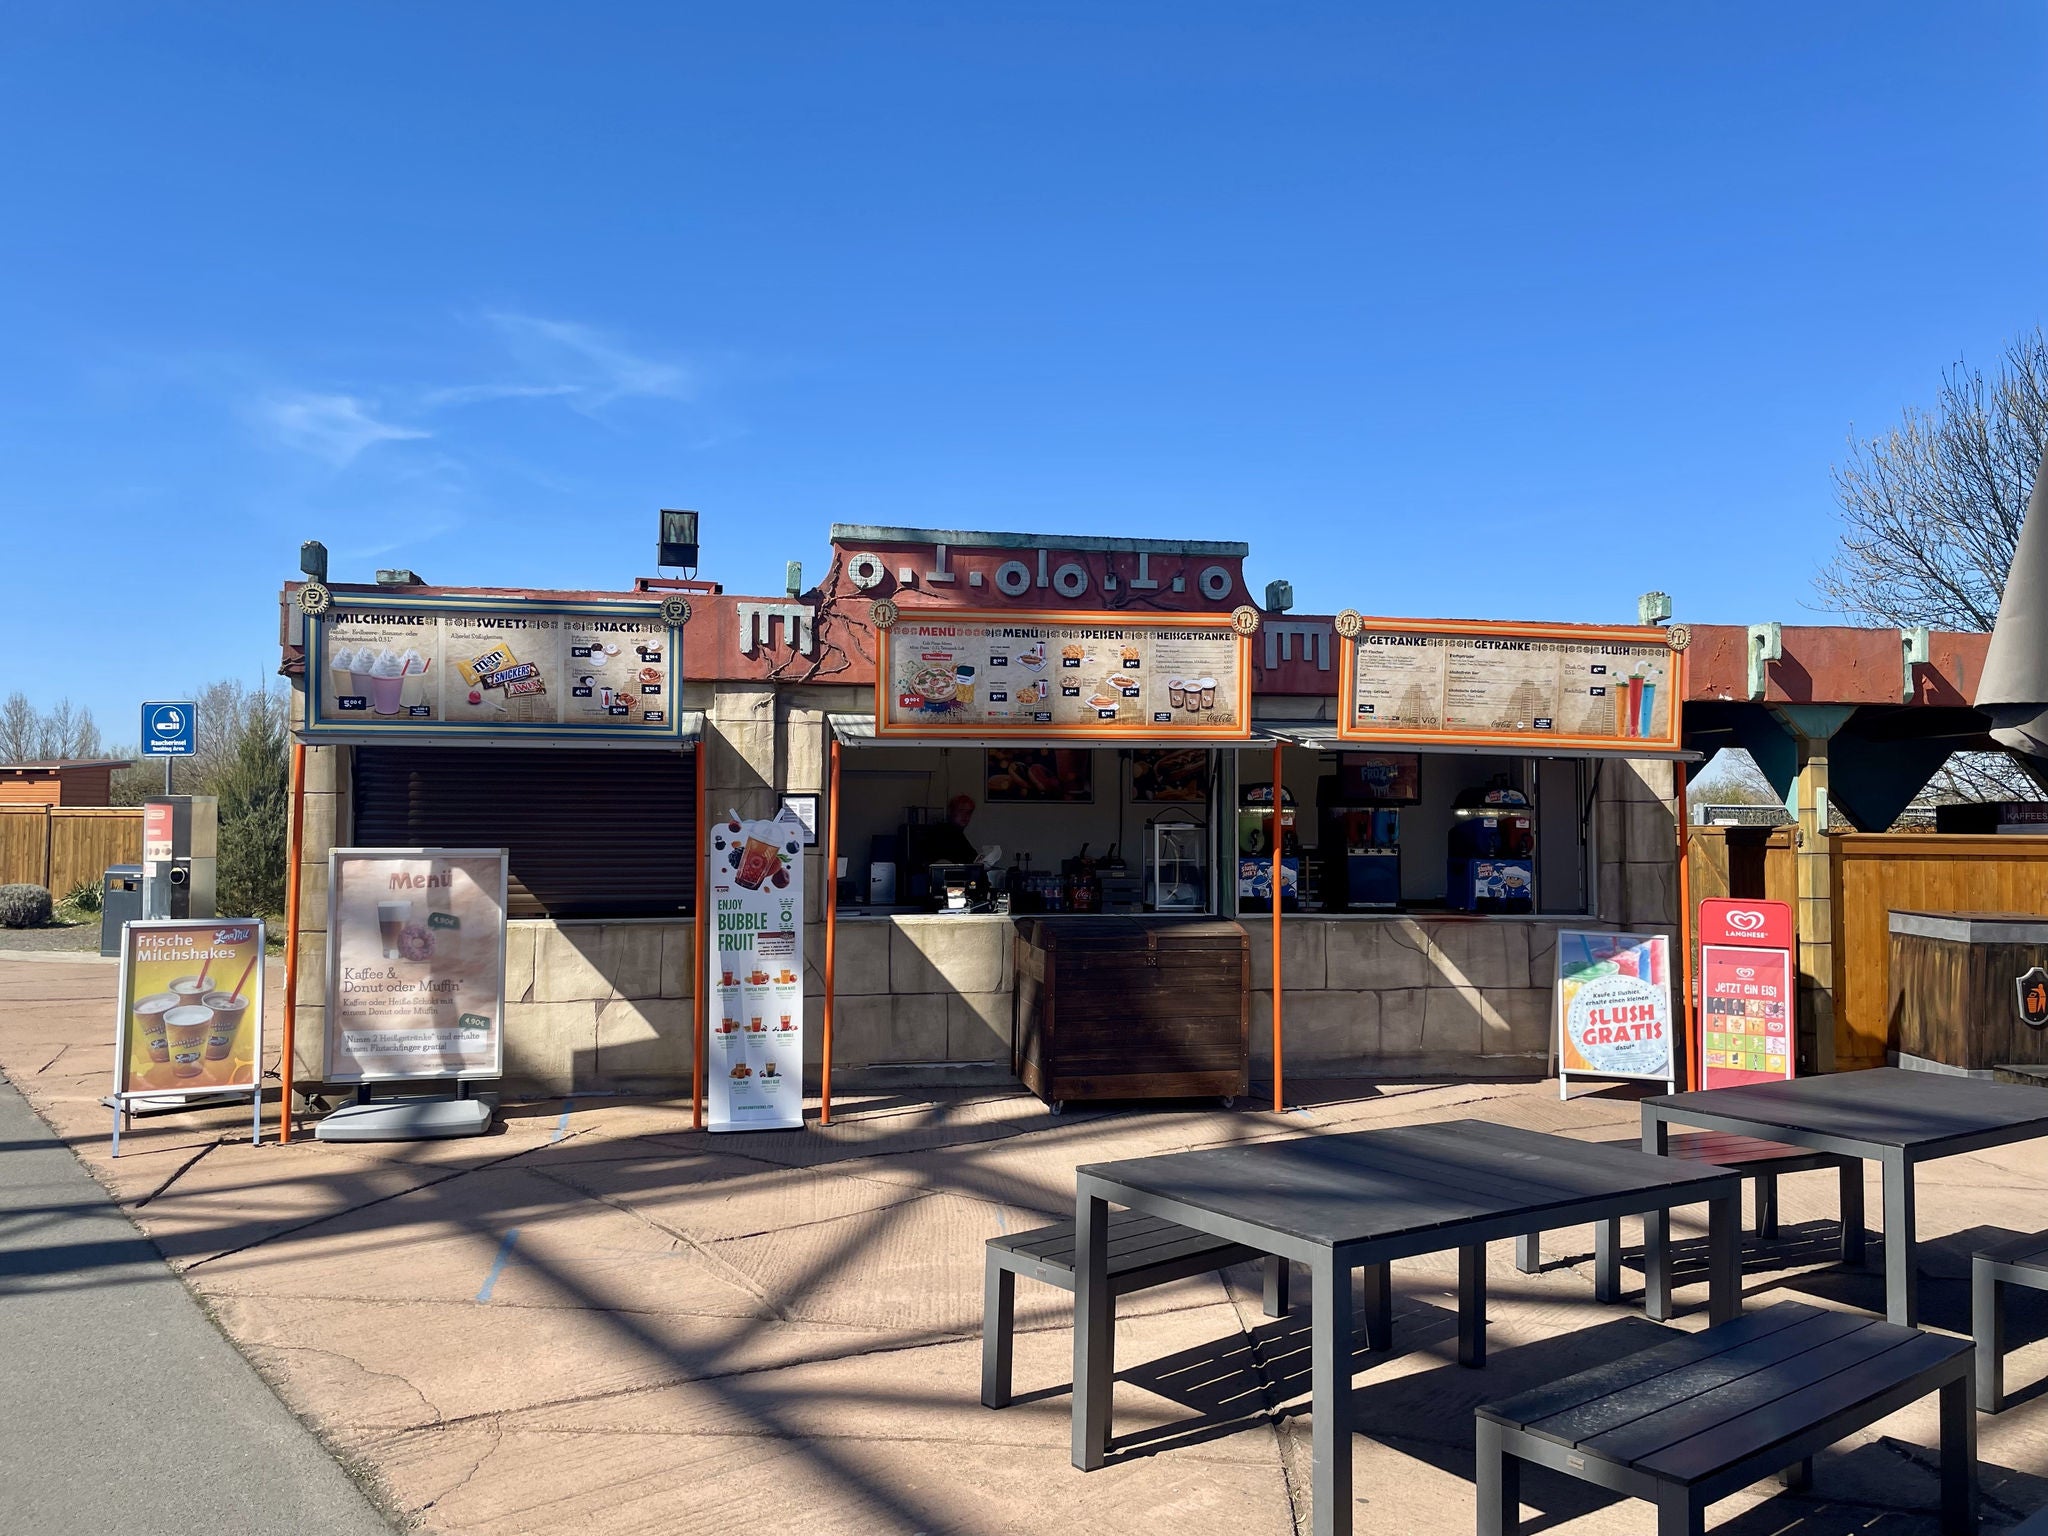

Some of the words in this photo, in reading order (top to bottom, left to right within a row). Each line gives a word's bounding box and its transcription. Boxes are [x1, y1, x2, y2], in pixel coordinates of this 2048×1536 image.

[336, 614, 424, 625] MILCHSHAKE
[477, 618, 526, 629] SWEETS
[594, 622, 640, 633] SNACKS
[1003, 627, 1039, 638] MENÜ
[1081, 630, 1123, 640] SPEISEN
[1601, 646, 1630, 656] SLUSH
[494, 665, 530, 683] SNICKERS
[389, 870, 453, 890] Menü
[718, 899, 743, 910] ENJOY
[718, 912, 767, 931] BUBBLE
[138, 934, 193, 947] Frische
[718, 933, 754, 951] FRUIT
[137, 947, 236, 962] Milchshakes
[344, 967, 383, 980] Kaffee
[386, 967, 398, 979] &
[344, 981, 384, 993] Donut
[386, 980, 416, 993] oder
[343, 998, 367, 1006] Kaffee
[368, 998, 386, 1006] oder
[368, 1008, 393, 1016] Donut
[394, 1007, 413, 1015] oder
[414, 1007, 438, 1015] Muffin
[1589, 1004, 1654, 1026] SLUSH
[346, 1035, 371, 1043] Nimm
[436, 1032, 452, 1041] und
[453, 1031, 480, 1040] erhalte
[1582, 1021, 1662, 1045] GRATIS
